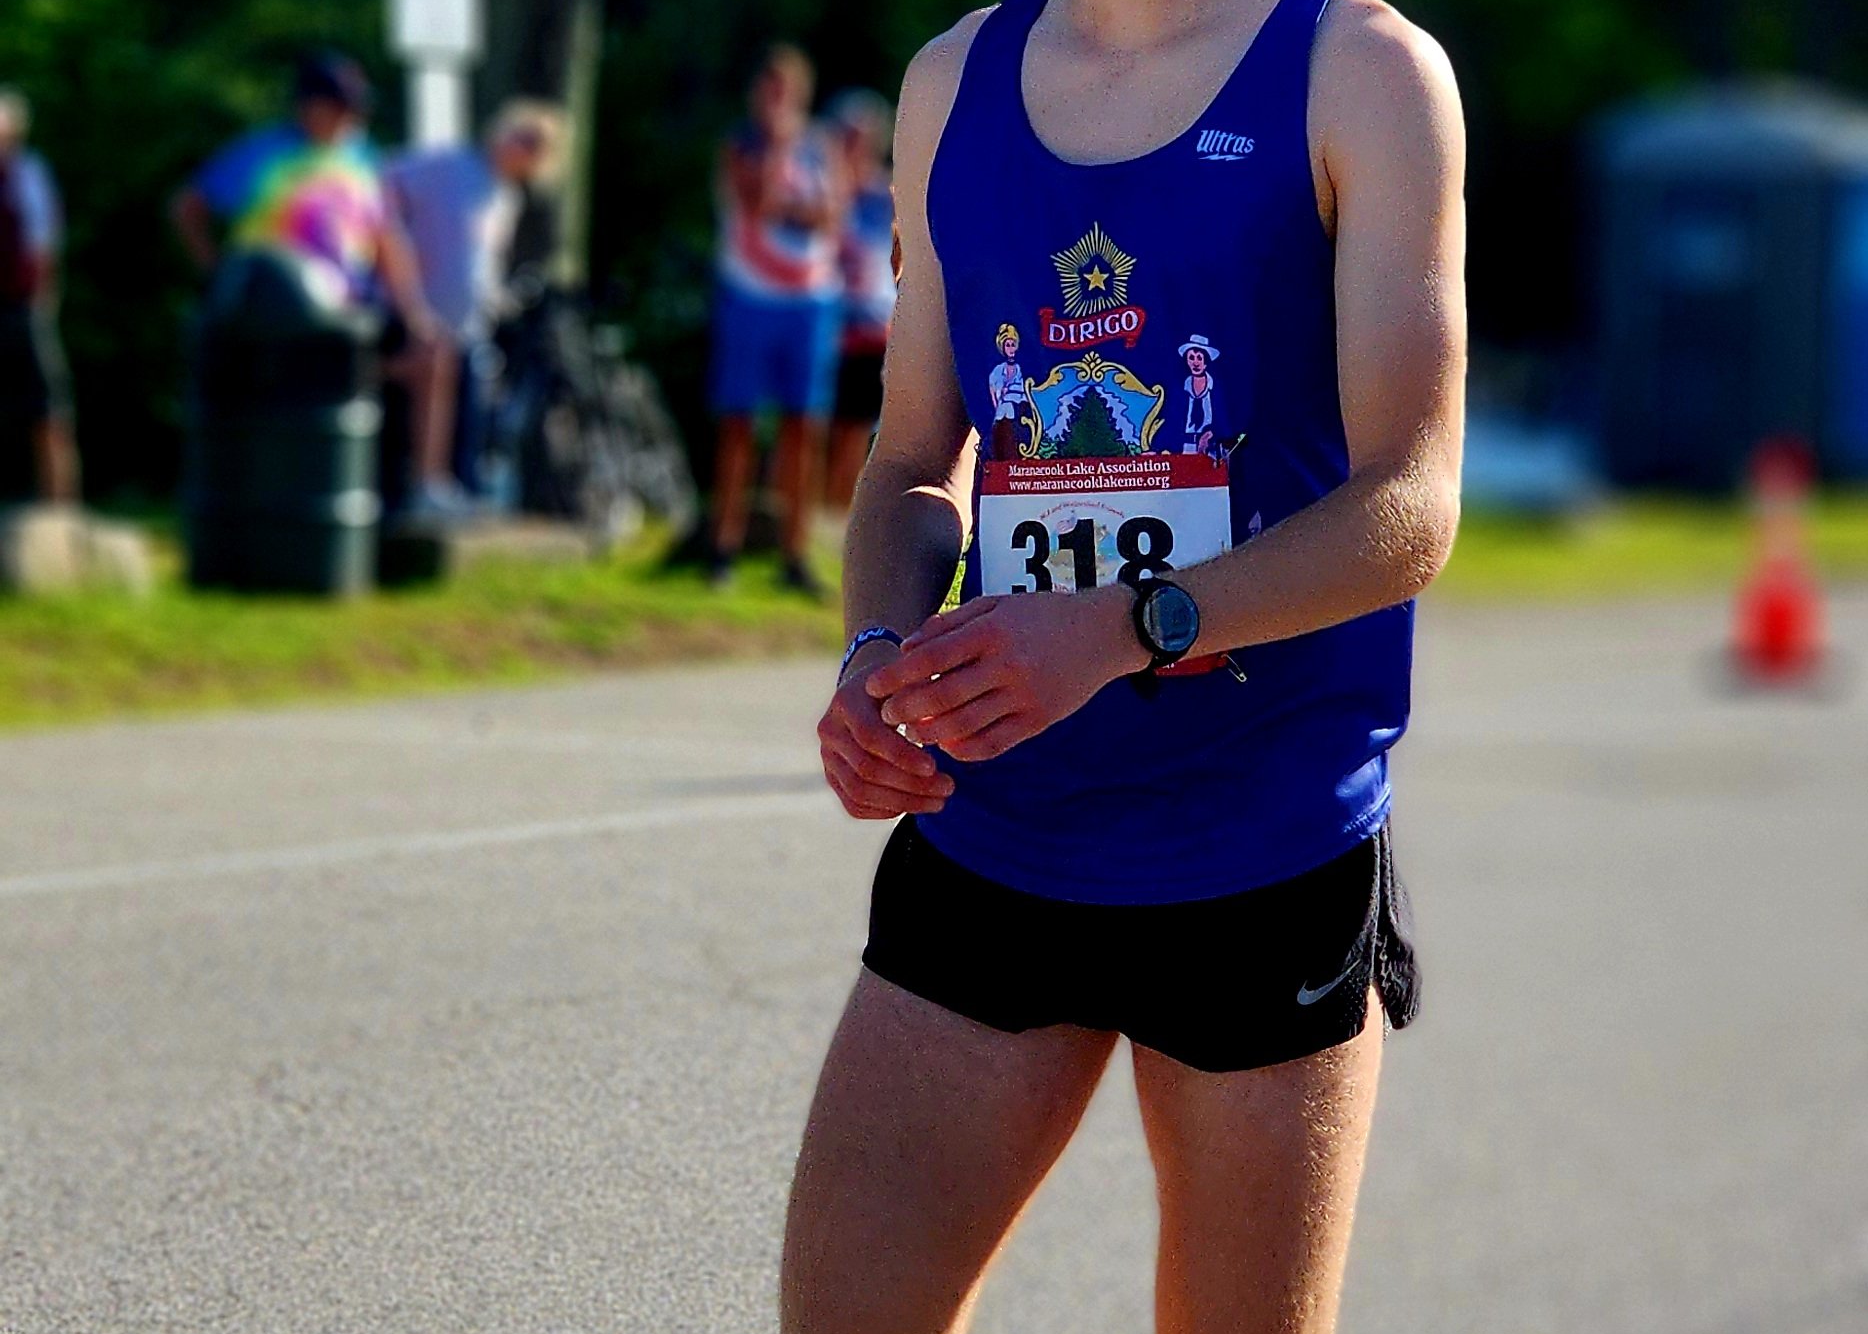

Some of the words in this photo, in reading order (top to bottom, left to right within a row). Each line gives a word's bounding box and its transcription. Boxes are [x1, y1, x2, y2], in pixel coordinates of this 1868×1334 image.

[1196, 129, 1256, 154] Ultras
[1049, 310, 1139, 344] DIRIGO
[1008, 463, 1064, 476] Maranacook
[1066, 463, 1095, 476] Lake
[1097, 459, 1171, 475] Association
[1009, 474, 1171, 491] www.maranacooklakeme.org
[1011, 516, 1174, 593] 318
